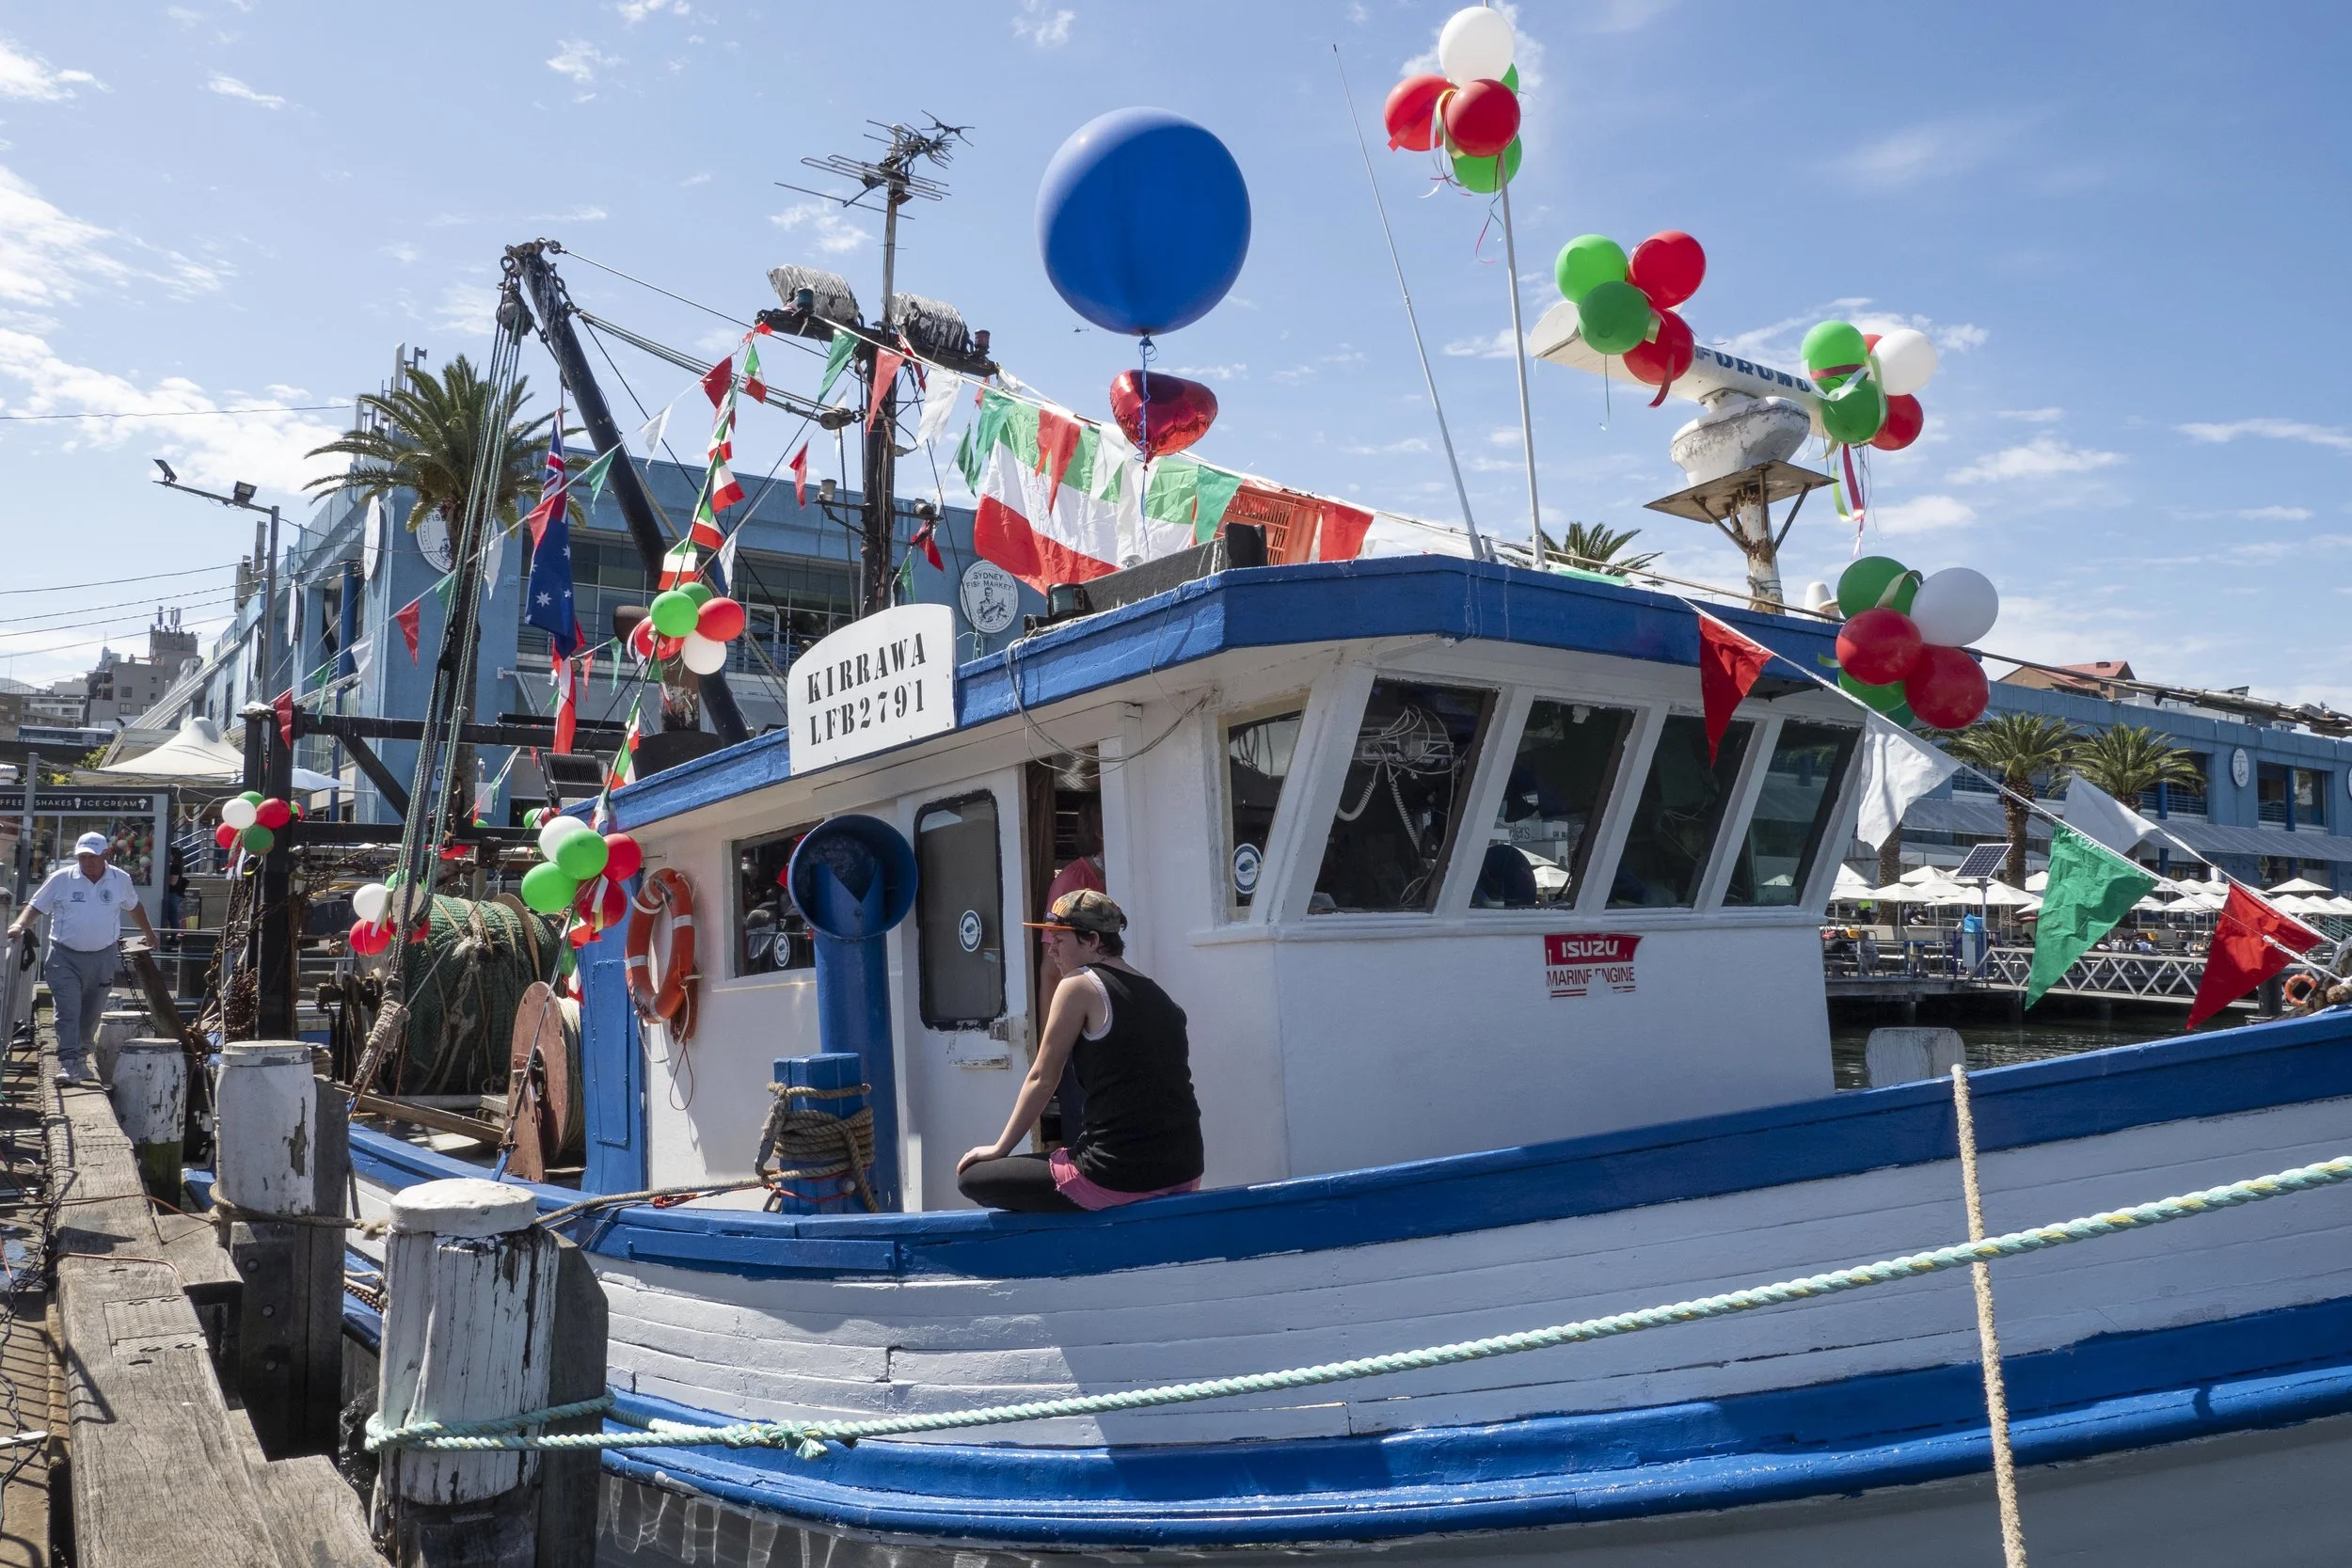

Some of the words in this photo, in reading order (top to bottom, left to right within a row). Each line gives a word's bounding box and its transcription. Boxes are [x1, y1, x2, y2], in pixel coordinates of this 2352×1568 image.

[1694, 345, 1812, 393] FURUNO
[973, 571, 1004, 580] SYDNEY
[983, 579, 1012, 591] MARKET
[806, 632, 927, 705] KIRRAWA
[809, 678, 925, 746] LFB2791
[1562, 940, 1619, 958] ISUZU
